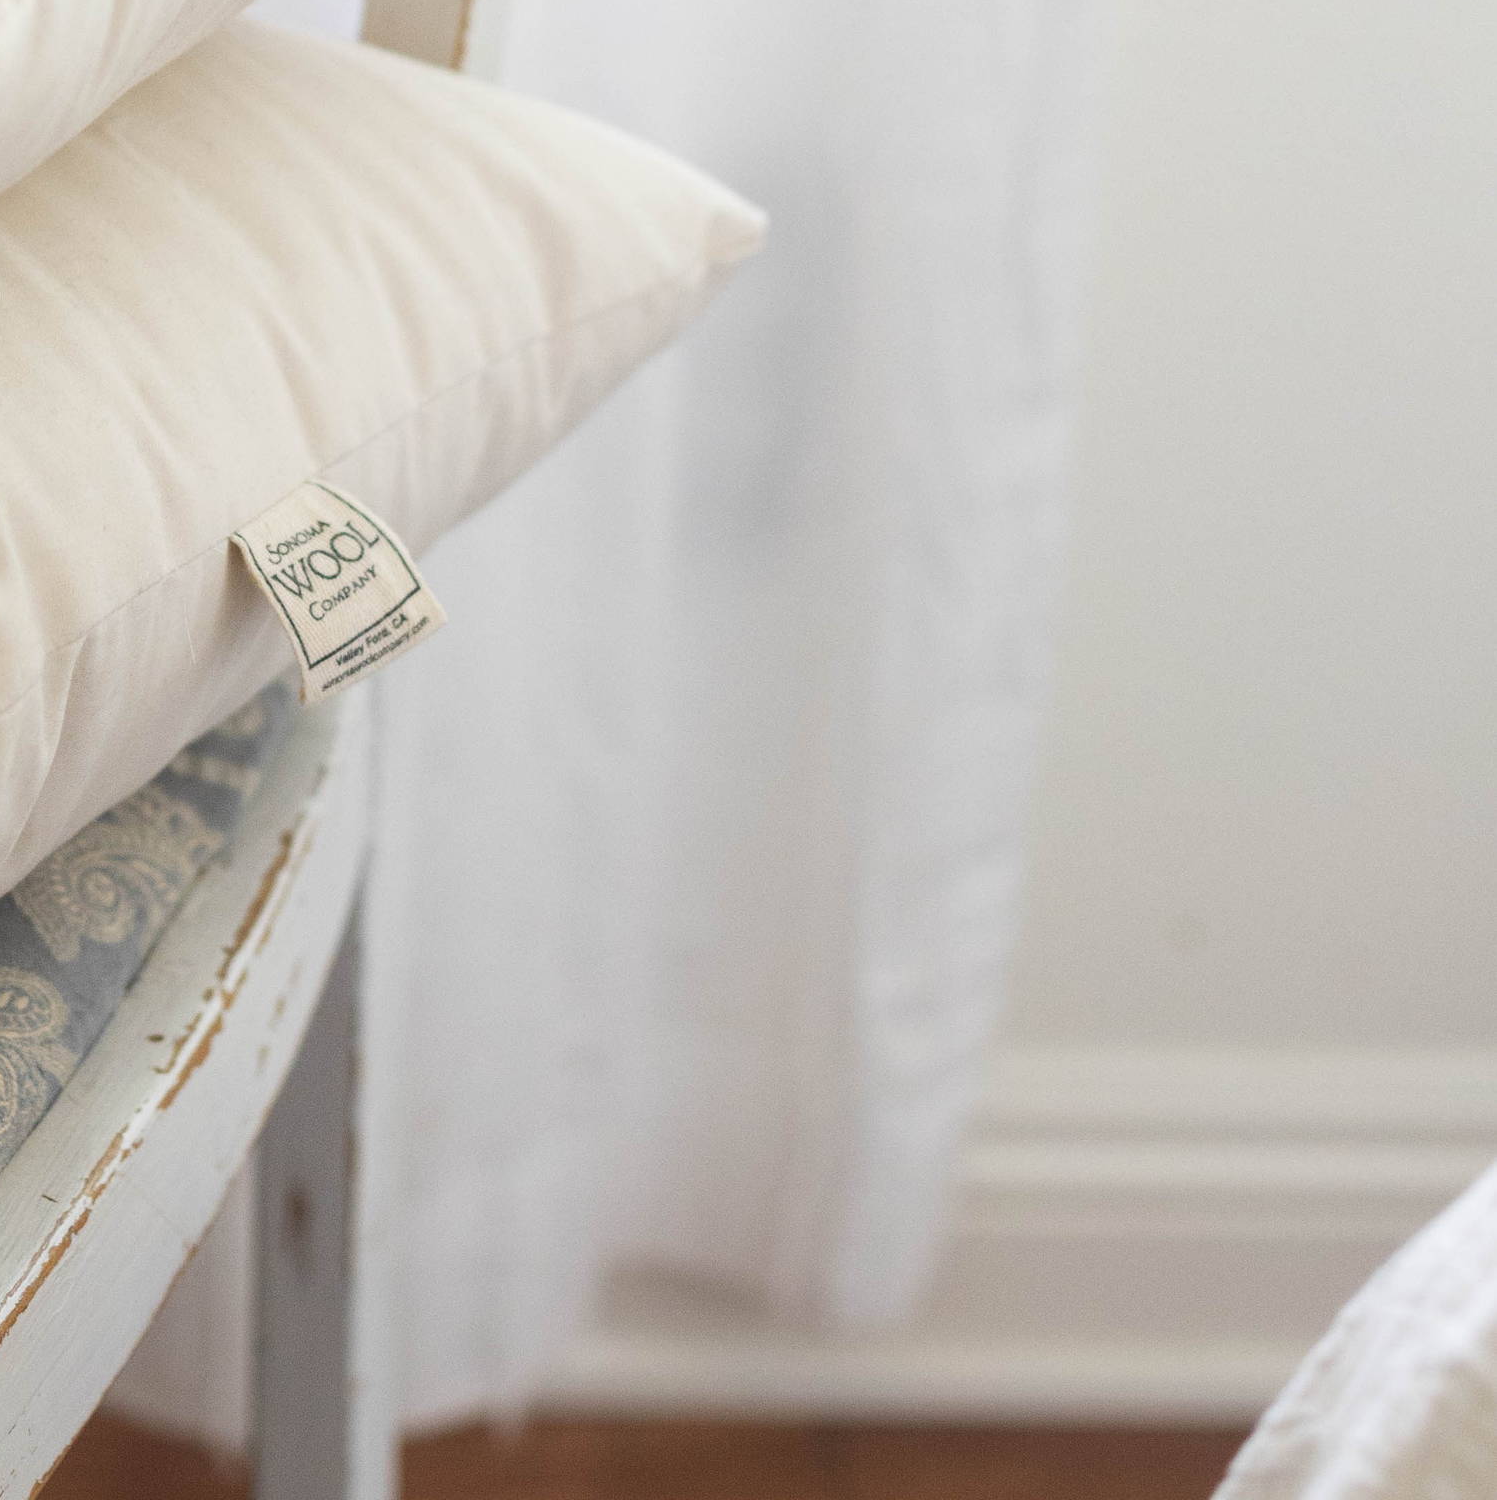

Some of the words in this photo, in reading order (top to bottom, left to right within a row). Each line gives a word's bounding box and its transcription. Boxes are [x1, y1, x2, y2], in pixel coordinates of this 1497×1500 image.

[265, 520, 331, 565] SONOMA
[271, 521, 380, 600] WOOL
[308, 564, 377, 622] COMPANY
[391, 612, 409, 629] CA
